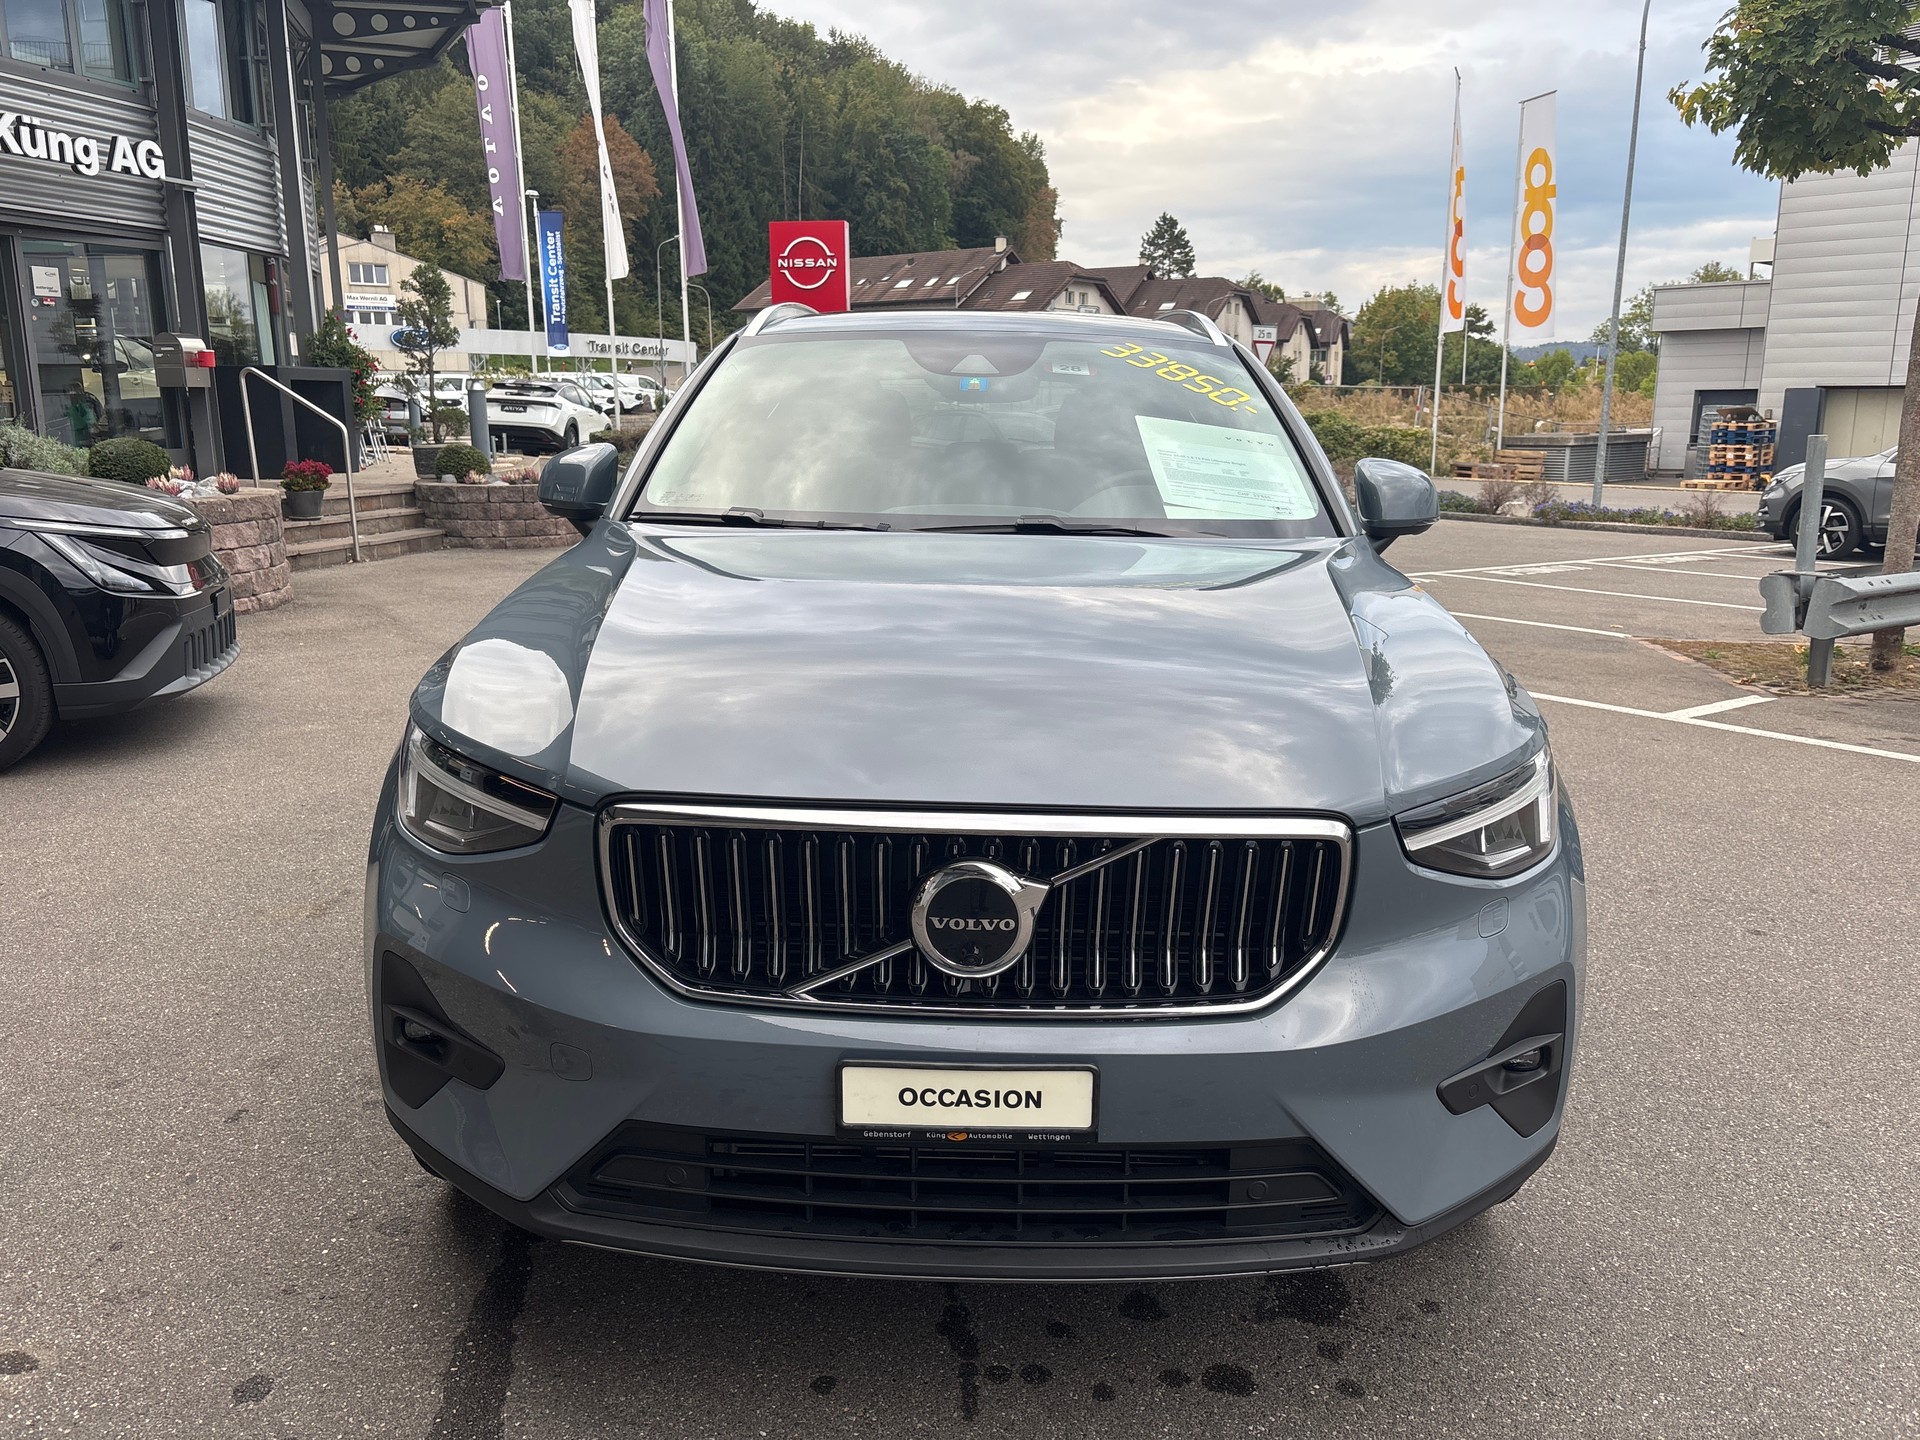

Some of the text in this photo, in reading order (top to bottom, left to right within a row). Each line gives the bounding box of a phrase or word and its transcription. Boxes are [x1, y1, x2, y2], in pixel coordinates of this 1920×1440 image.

[0, 112, 166, 179] Küng AG
[477, 74, 504, 217] VOLVO
[1514, 147, 1557, 328] coop
[777, 258, 838, 268] NISSAN
[546, 230, 561, 324] Transit Center
[1258, 329, 1266, 339] 25
[1224, 436, 1275, 447] VOLVO
[929, 916, 1016, 931] VOLVO
[898, 1087, 1043, 1109] OCCASION
[863, 1130, 1071, 1141] Gebenstorf Küng Automobile Wettingen
